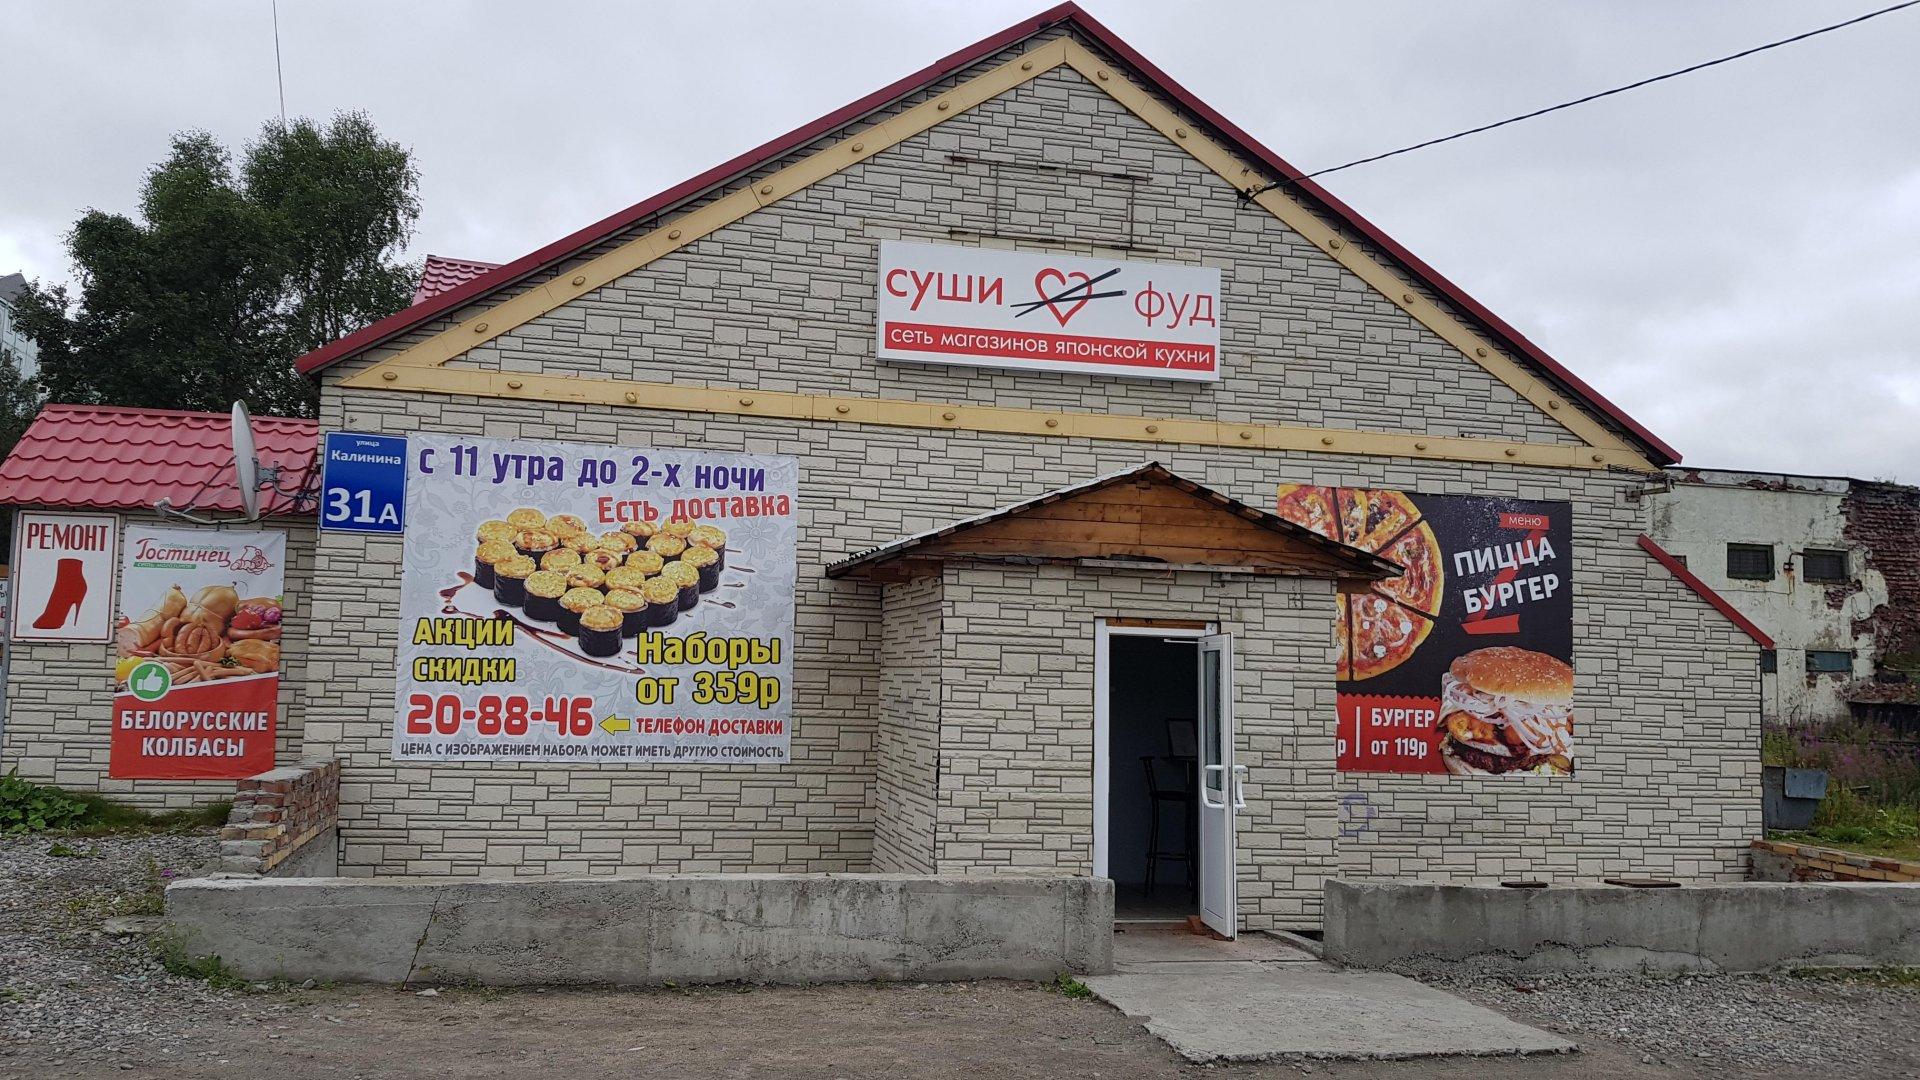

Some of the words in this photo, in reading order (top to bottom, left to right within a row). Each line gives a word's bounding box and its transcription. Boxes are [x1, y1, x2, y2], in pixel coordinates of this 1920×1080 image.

[886, 268, 1003, 311] суши
[1134, 280, 1216, 329] фуд
[890, 328, 934, 344] сеть
[940, 333, 1048, 353] магазинов
[1055, 341, 1147, 360] японской
[1155, 347, 1210, 368] кухни
[331, 449, 402, 465] Калинина
[355, 440, 380, 448] улица
[449, 445, 478, 477] 11
[492, 453, 564, 486] утра
[577, 458, 617, 488] до
[631, 455, 682, 488] 2-х
[694, 465, 765, 492] ночи
[598, 496, 659, 524] Есть
[670, 494, 790, 524] доставка
[1508, 516, 1542, 526] меню
[26, 522, 109, 552] РЕМОНТ
[135, 537, 232, 568] Гостинец
[1453, 536, 1557, 577] ПИЦЦА
[1463, 573, 1559, 614] БУРГЕР
[637, 631, 782, 670] Наборы
[636, 676, 680, 705] от
[692, 671, 781, 710] 359р
[120, 710, 268, 731] БЕЛОРУССКИЕ
[406, 693, 594, 737] 20-88-46
[636, 716, 705, 736] ТЕЛЕФОН
[707, 719, 783, 737] ДОСТАВКИ
[1371, 707, 1435, 728] БУРГЕР
[142, 737, 245, 757] КОЛБАСЫ
[400, 743, 433, 756] ЦЕНА
[435, 743, 443, 755] С
[447, 743, 541, 757] ИЗОБРАЖЕНИЕМ
[543, 744, 589, 757] НАБОРА
[591, 745, 633, 757] МОЖЕТ
[635, 745, 671, 757] ИМЕТЬ
[673, 745, 719, 759] ДРУГУЮ
[720, 746, 784, 758] СТОИМОСТЬ
[1371, 739, 1389, 755] от
[1394, 737, 1428, 759] 119р
